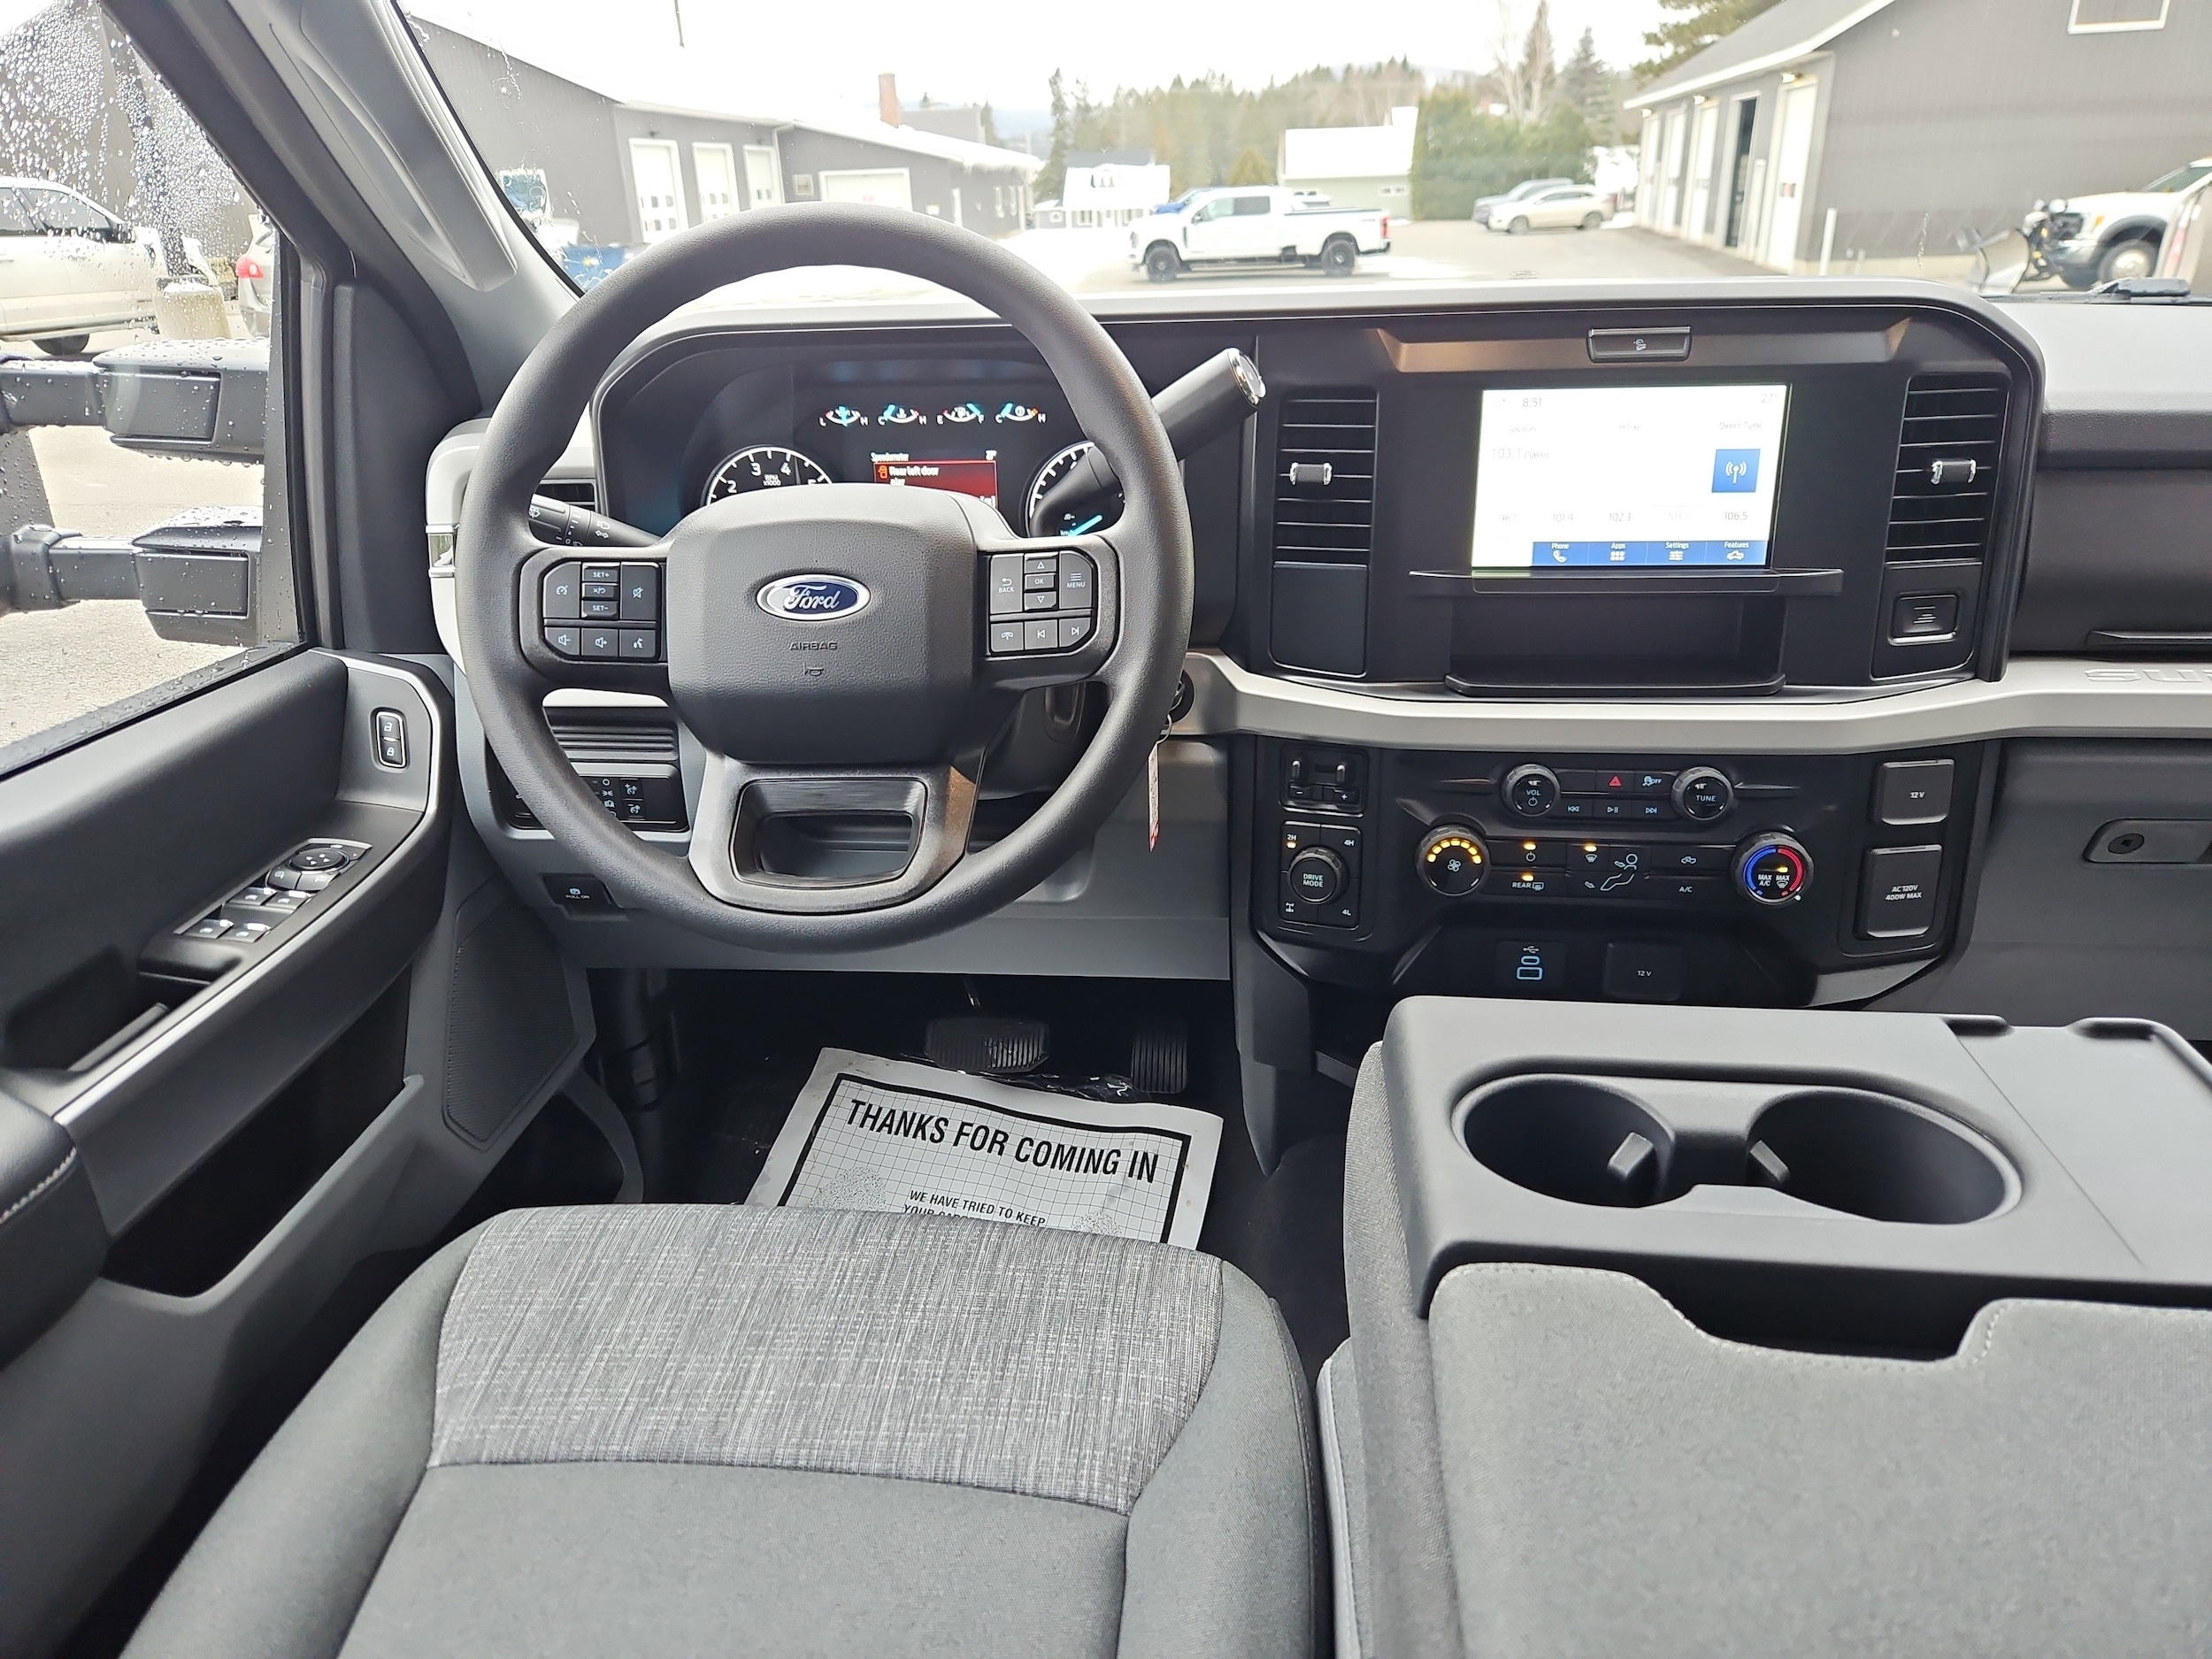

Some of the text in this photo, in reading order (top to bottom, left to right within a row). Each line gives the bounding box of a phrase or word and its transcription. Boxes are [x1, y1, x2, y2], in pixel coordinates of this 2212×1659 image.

[1522, 397, 1542, 408] 8:51
[751, 462, 762, 476] 3
[780, 462, 791, 476] 4
[888, 465, 940, 476] Rear left door
[726, 480, 737, 494] 2
[1724, 511, 1748, 522] 106.5
[1665, 541, 1689, 550] Settings
[1724, 541, 1749, 549] Features
[1034, 577, 1045, 586] OK
[1066, 580, 1087, 589] MENU
[998, 585, 1015, 595] BACK
[783, 584, 841, 611] Ford
[789, 641, 838, 652] AIRBAG
[2084, 668, 2212, 683] SU
[1302, 879, 1324, 888] MODE
[1678, 885, 1694, 894] A/C
[846, 1099, 1159, 1183] THANKS FOR COMING IN
[910, 1190, 928, 1202] WE
[929, 1194, 959, 1209] HAVE
[962, 1200, 995, 1215] TRIED
[998, 1206, 1013, 1219] TO
[1016, 1211, 1046, 1226] KEEP
